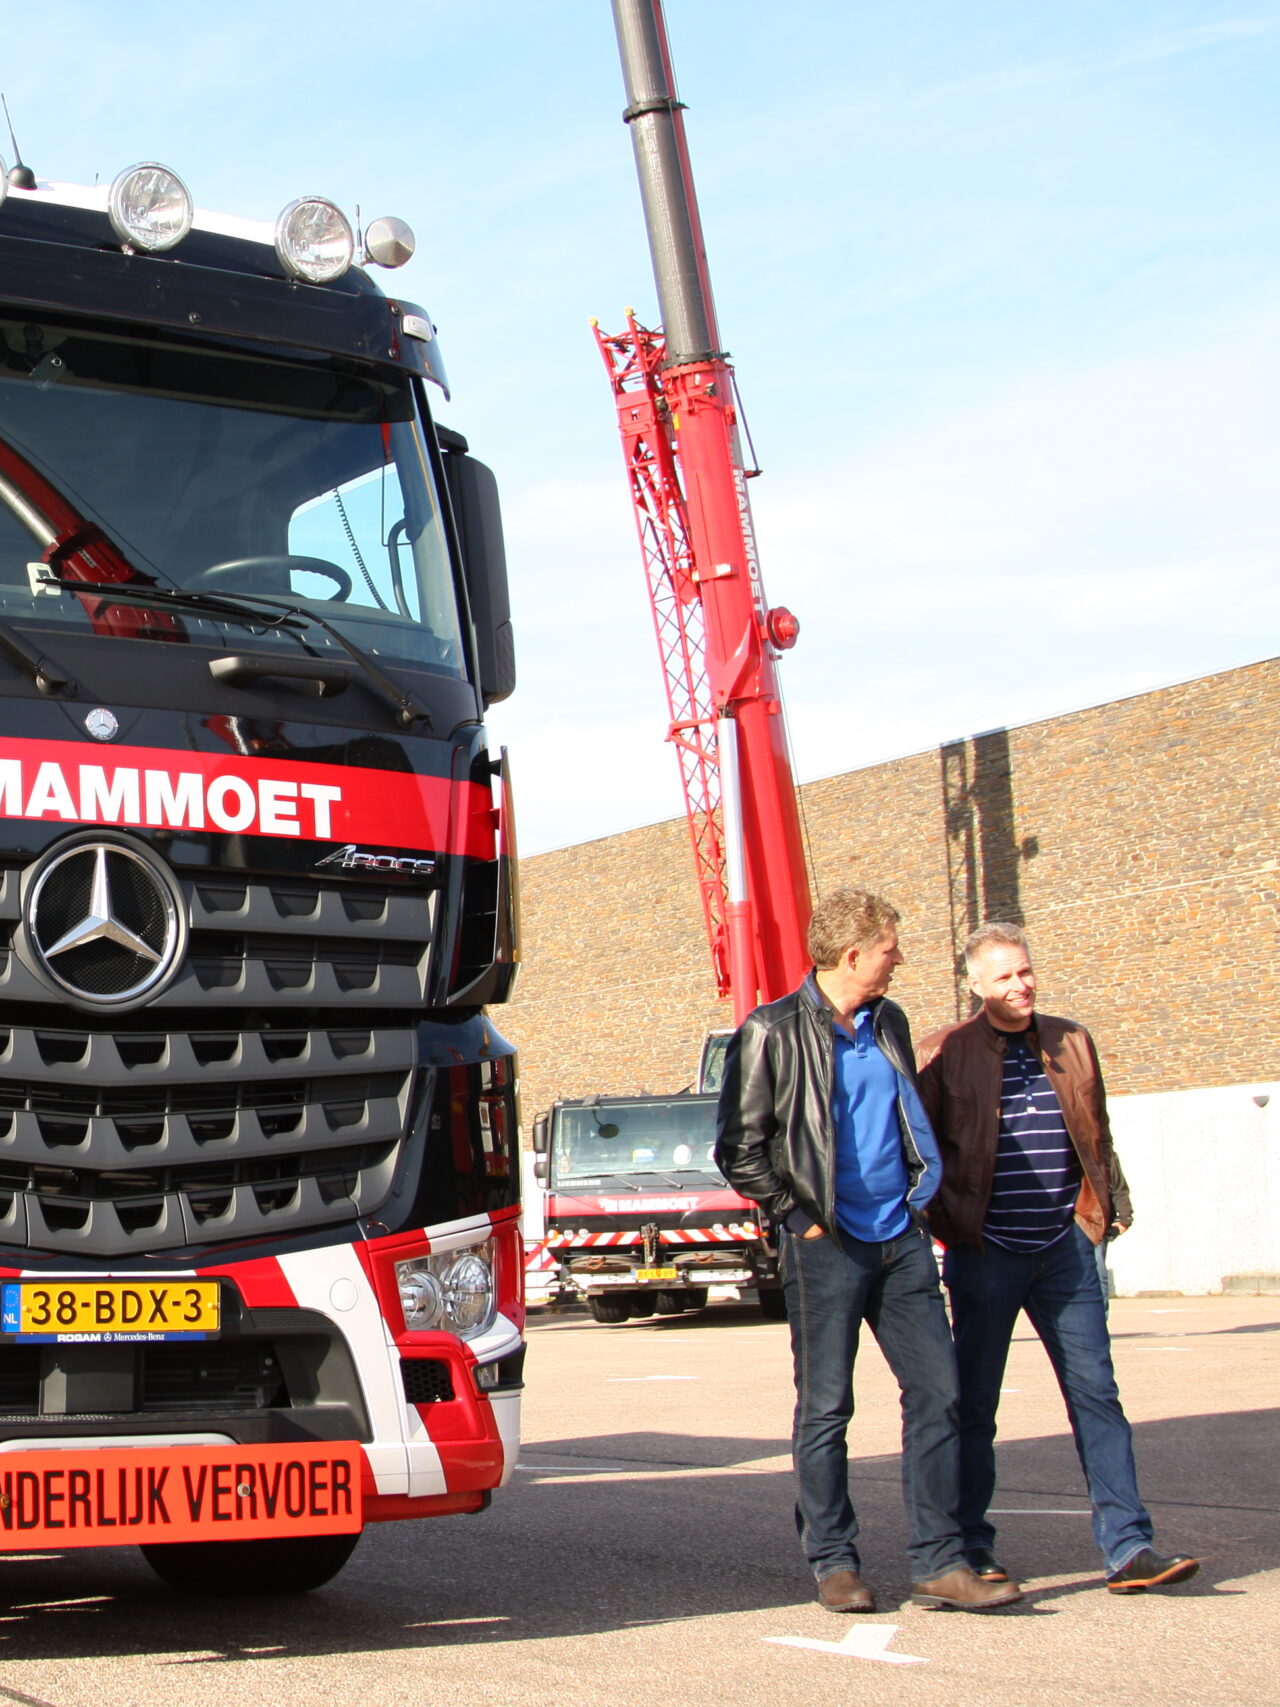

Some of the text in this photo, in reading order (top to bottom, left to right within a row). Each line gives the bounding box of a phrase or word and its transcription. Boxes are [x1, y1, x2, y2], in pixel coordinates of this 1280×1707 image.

[732, 469, 765, 615] MAMMOET
[619, 1197, 699, 1212] MAMMOET
[3, 1313, 19, 1324] NL
[31, 1289, 203, 1325] 38-BDX-3
[57, 1332, 166, 1343] ROGAM Mercedes-Benz
[183, 1459, 352, 1522] VERVOER
